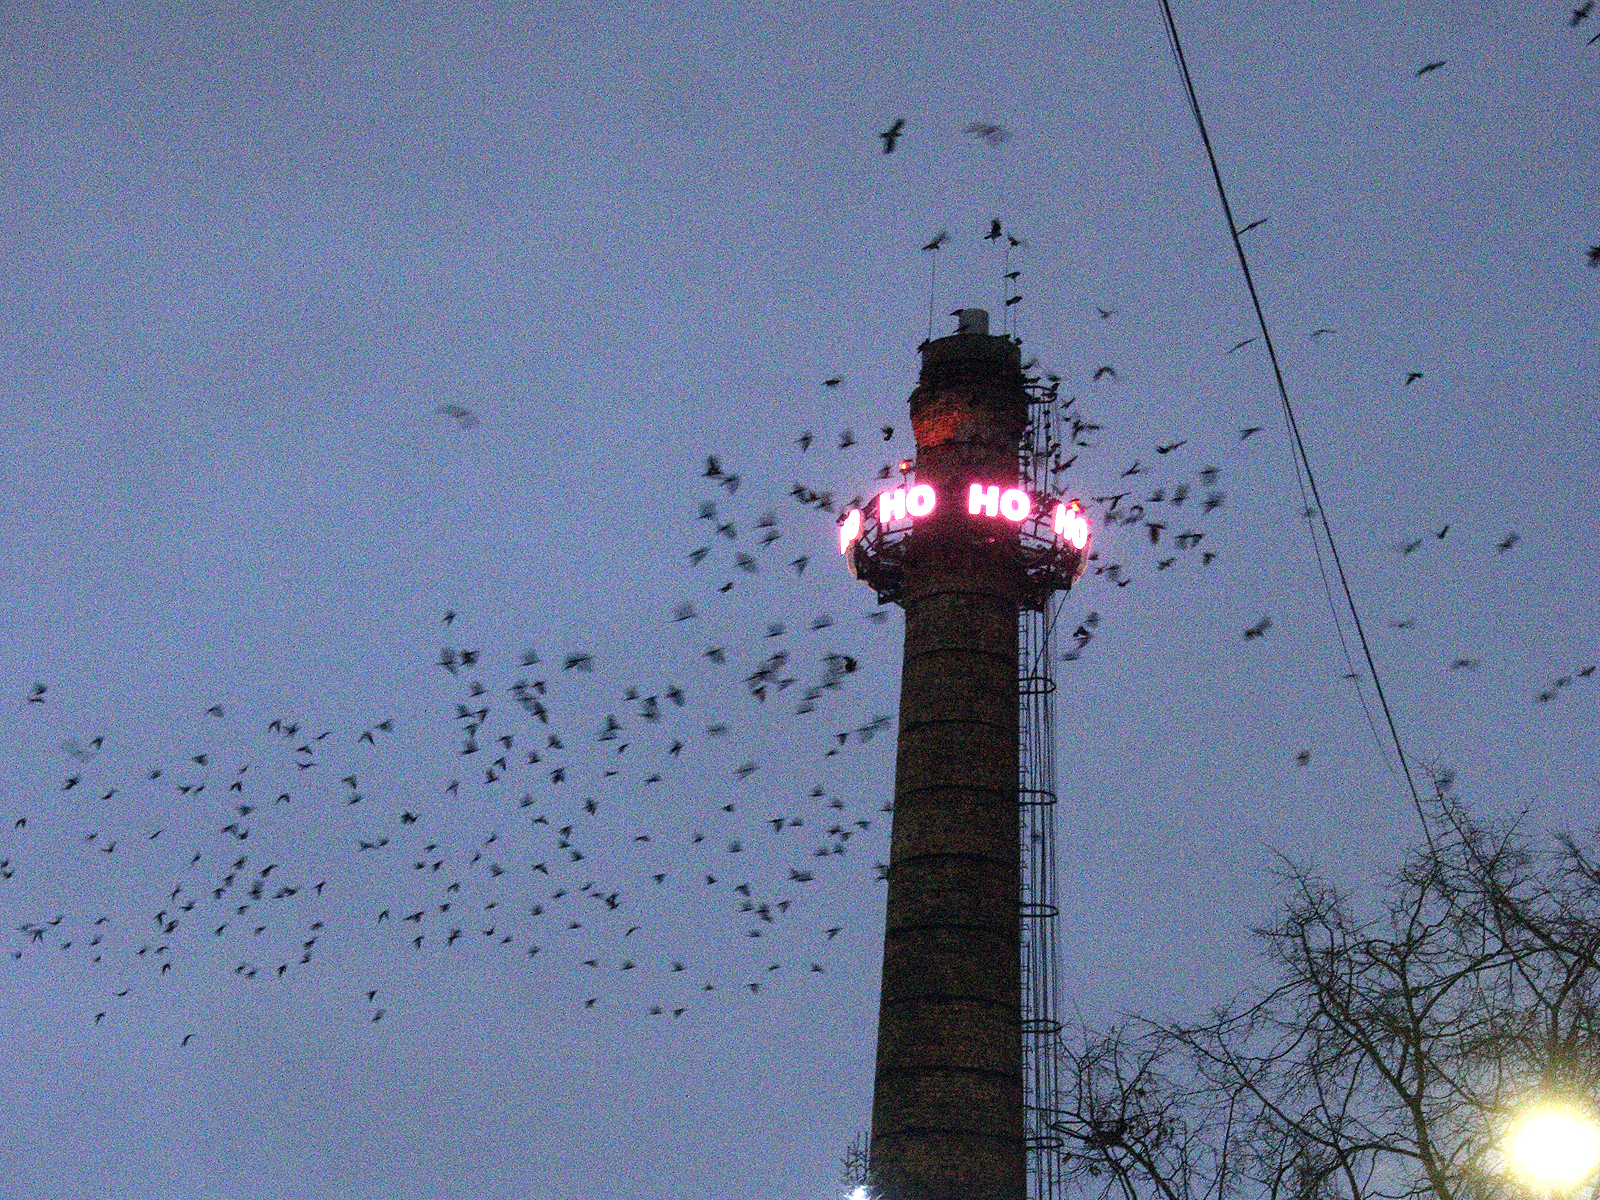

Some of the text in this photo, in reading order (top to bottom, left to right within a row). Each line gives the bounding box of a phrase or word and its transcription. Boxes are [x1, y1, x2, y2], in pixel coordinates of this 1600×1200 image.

[879, 484, 936, 524] HO
[968, 483, 1031, 522] HO
[1053, 503, 1089, 550] HO
